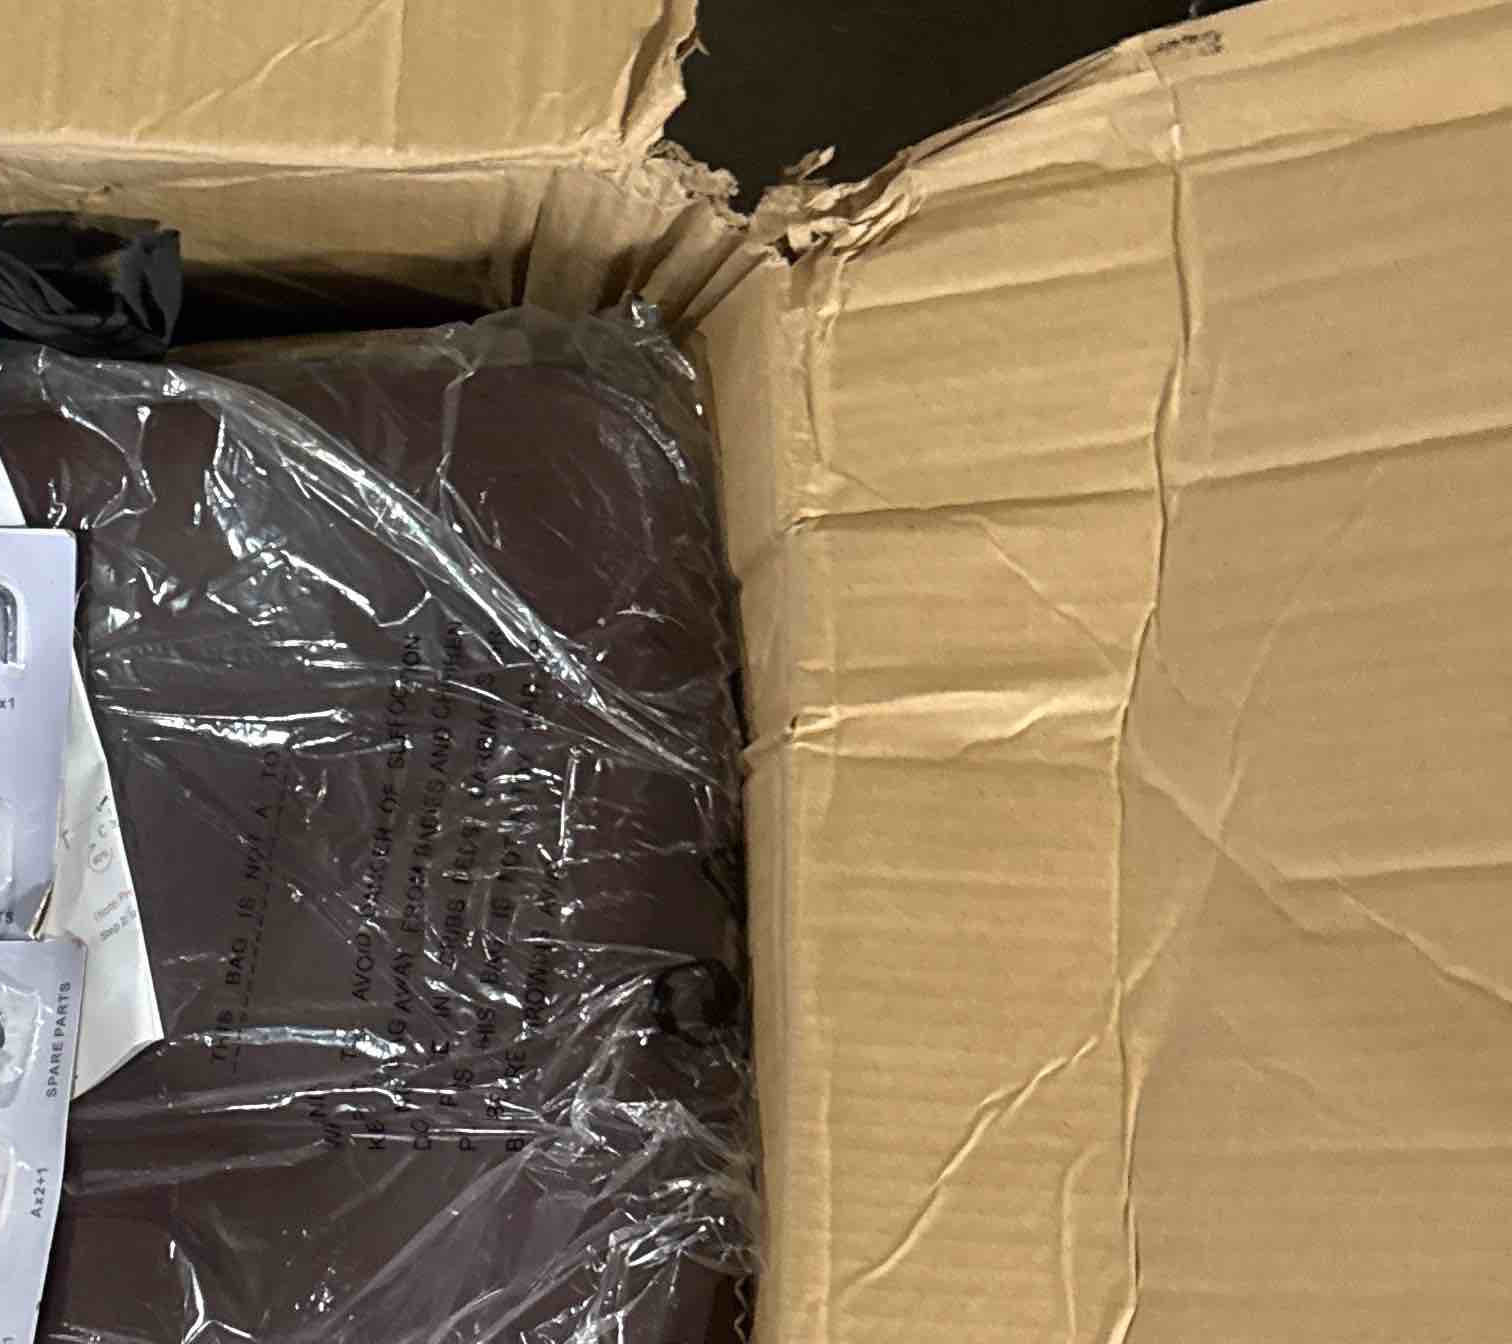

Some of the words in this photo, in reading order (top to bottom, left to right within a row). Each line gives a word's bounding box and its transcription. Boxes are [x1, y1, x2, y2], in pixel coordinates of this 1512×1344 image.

[351, 931, 375, 1002] AVOID
[53, 980, 73, 1034] PARTS
[44, 1038, 64, 1099] SPARE
[29, 1166, 49, 1219] Ax2+1
